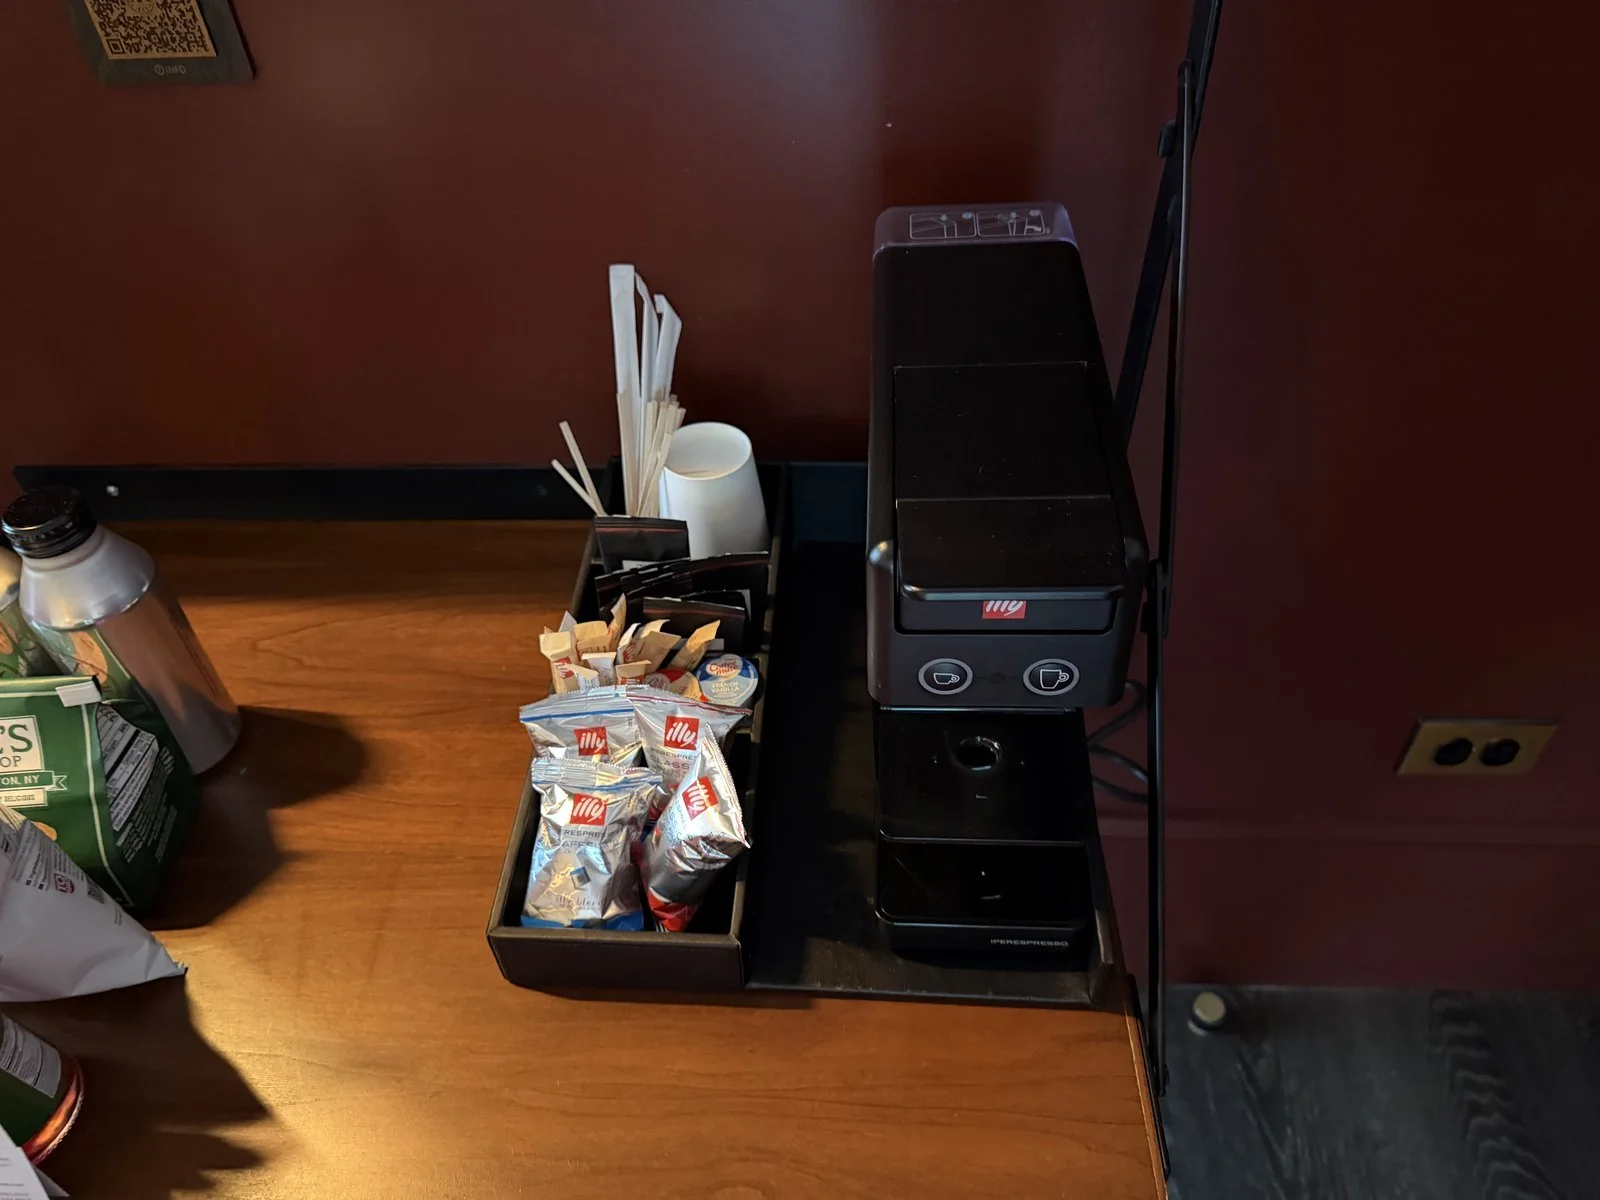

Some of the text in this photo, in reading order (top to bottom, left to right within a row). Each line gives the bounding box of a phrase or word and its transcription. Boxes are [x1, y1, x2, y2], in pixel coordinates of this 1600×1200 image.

[579, 732, 606, 754] illy
[663, 721, 698, 748] illy
[0, 774, 40, 785] ON, NY
[572, 796, 606, 823] illy
[686, 782, 710, 811] illy
